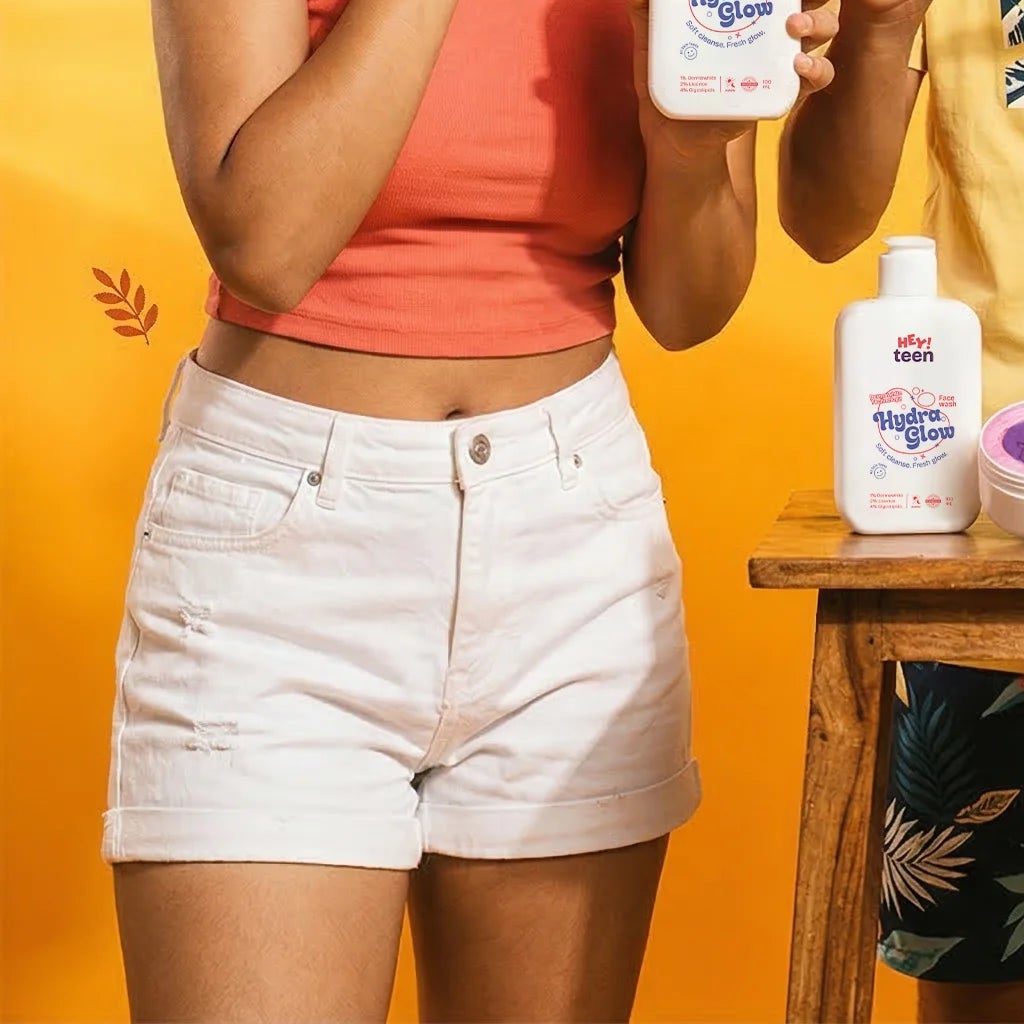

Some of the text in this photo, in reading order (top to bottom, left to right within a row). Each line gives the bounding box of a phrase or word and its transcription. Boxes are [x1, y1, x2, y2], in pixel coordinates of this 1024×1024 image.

[718, 1, 773, 28] Glow
[685, 20, 699, 36] Soft
[727, 39, 747, 49] Fresh
[897, 334, 932, 349] HEY!
[893, 349, 934, 363] teen
[873, 407, 942, 432] Hydra
[876, 443, 887, 457] Soft
[904, 425, 955, 450] Glow
